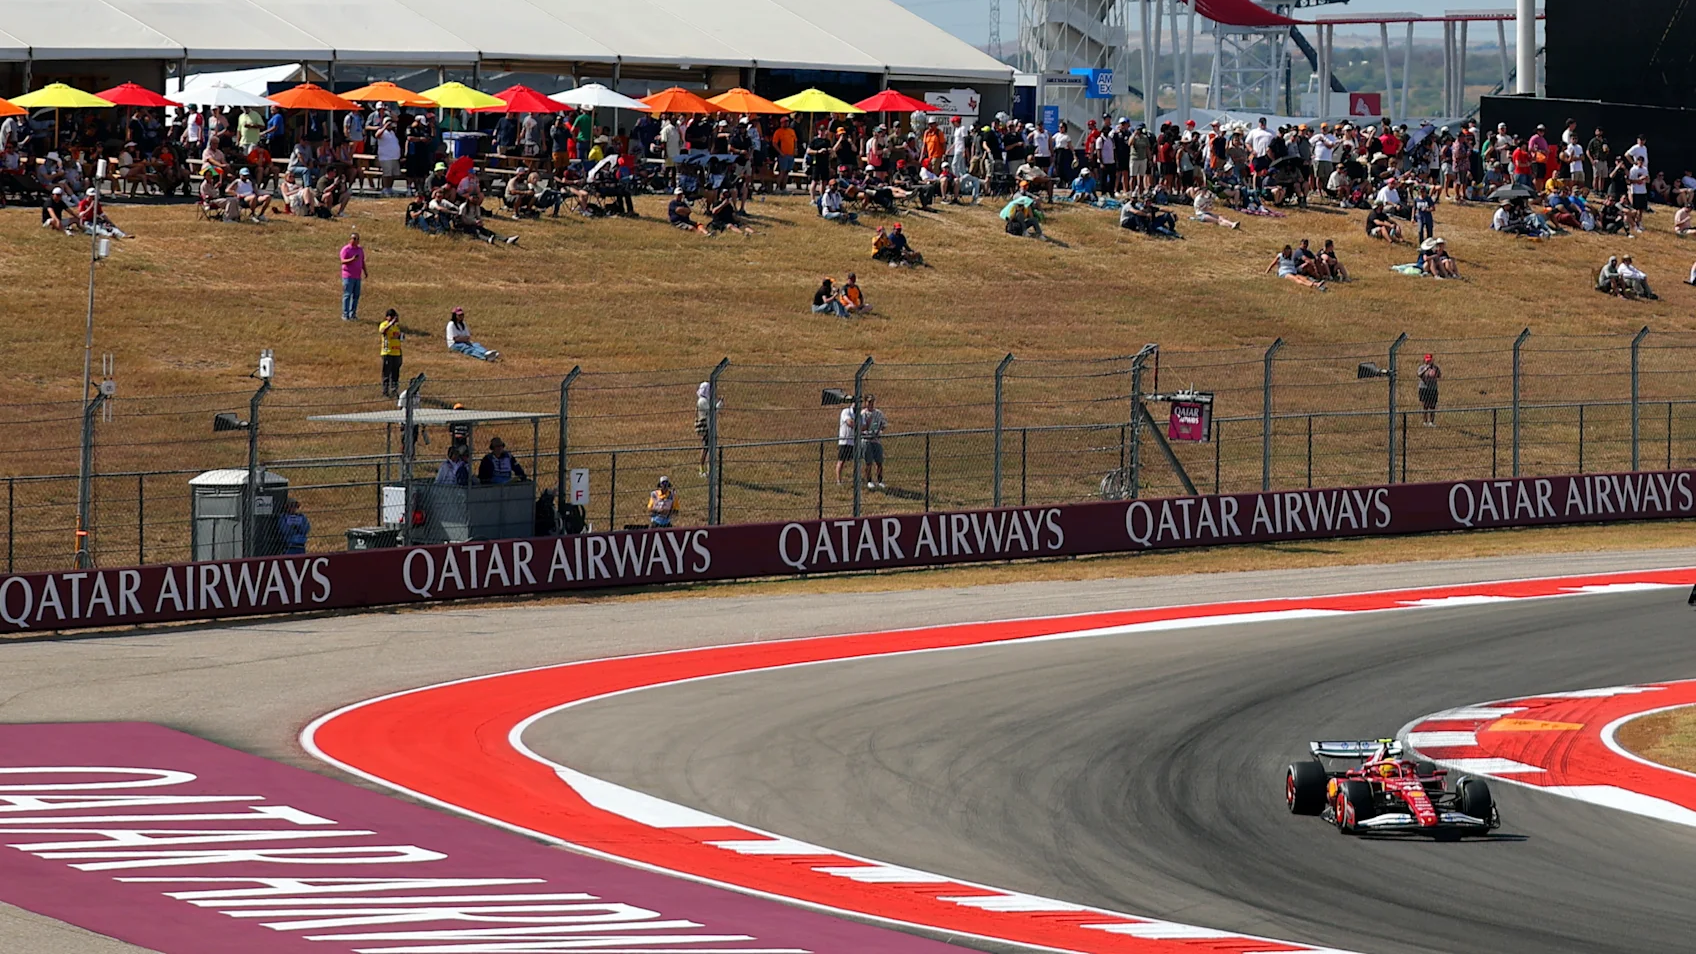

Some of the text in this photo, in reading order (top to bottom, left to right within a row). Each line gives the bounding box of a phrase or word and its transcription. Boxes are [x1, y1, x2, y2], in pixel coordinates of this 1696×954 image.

[1174, 406, 1199, 419] QATAR
[575, 472, 584, 484] 7
[576, 490, 584, 502] F
[1449, 473, 1692, 526] QATAR AIRWAYS
[779, 509, 1063, 570] QATAR AIRWAYS
[1126, 489, 1390, 546] QATAR AIRWAYS
[403, 530, 710, 597] QATAR AIRWAYS
[0, 558, 330, 627] QATAR AIRWAYS
